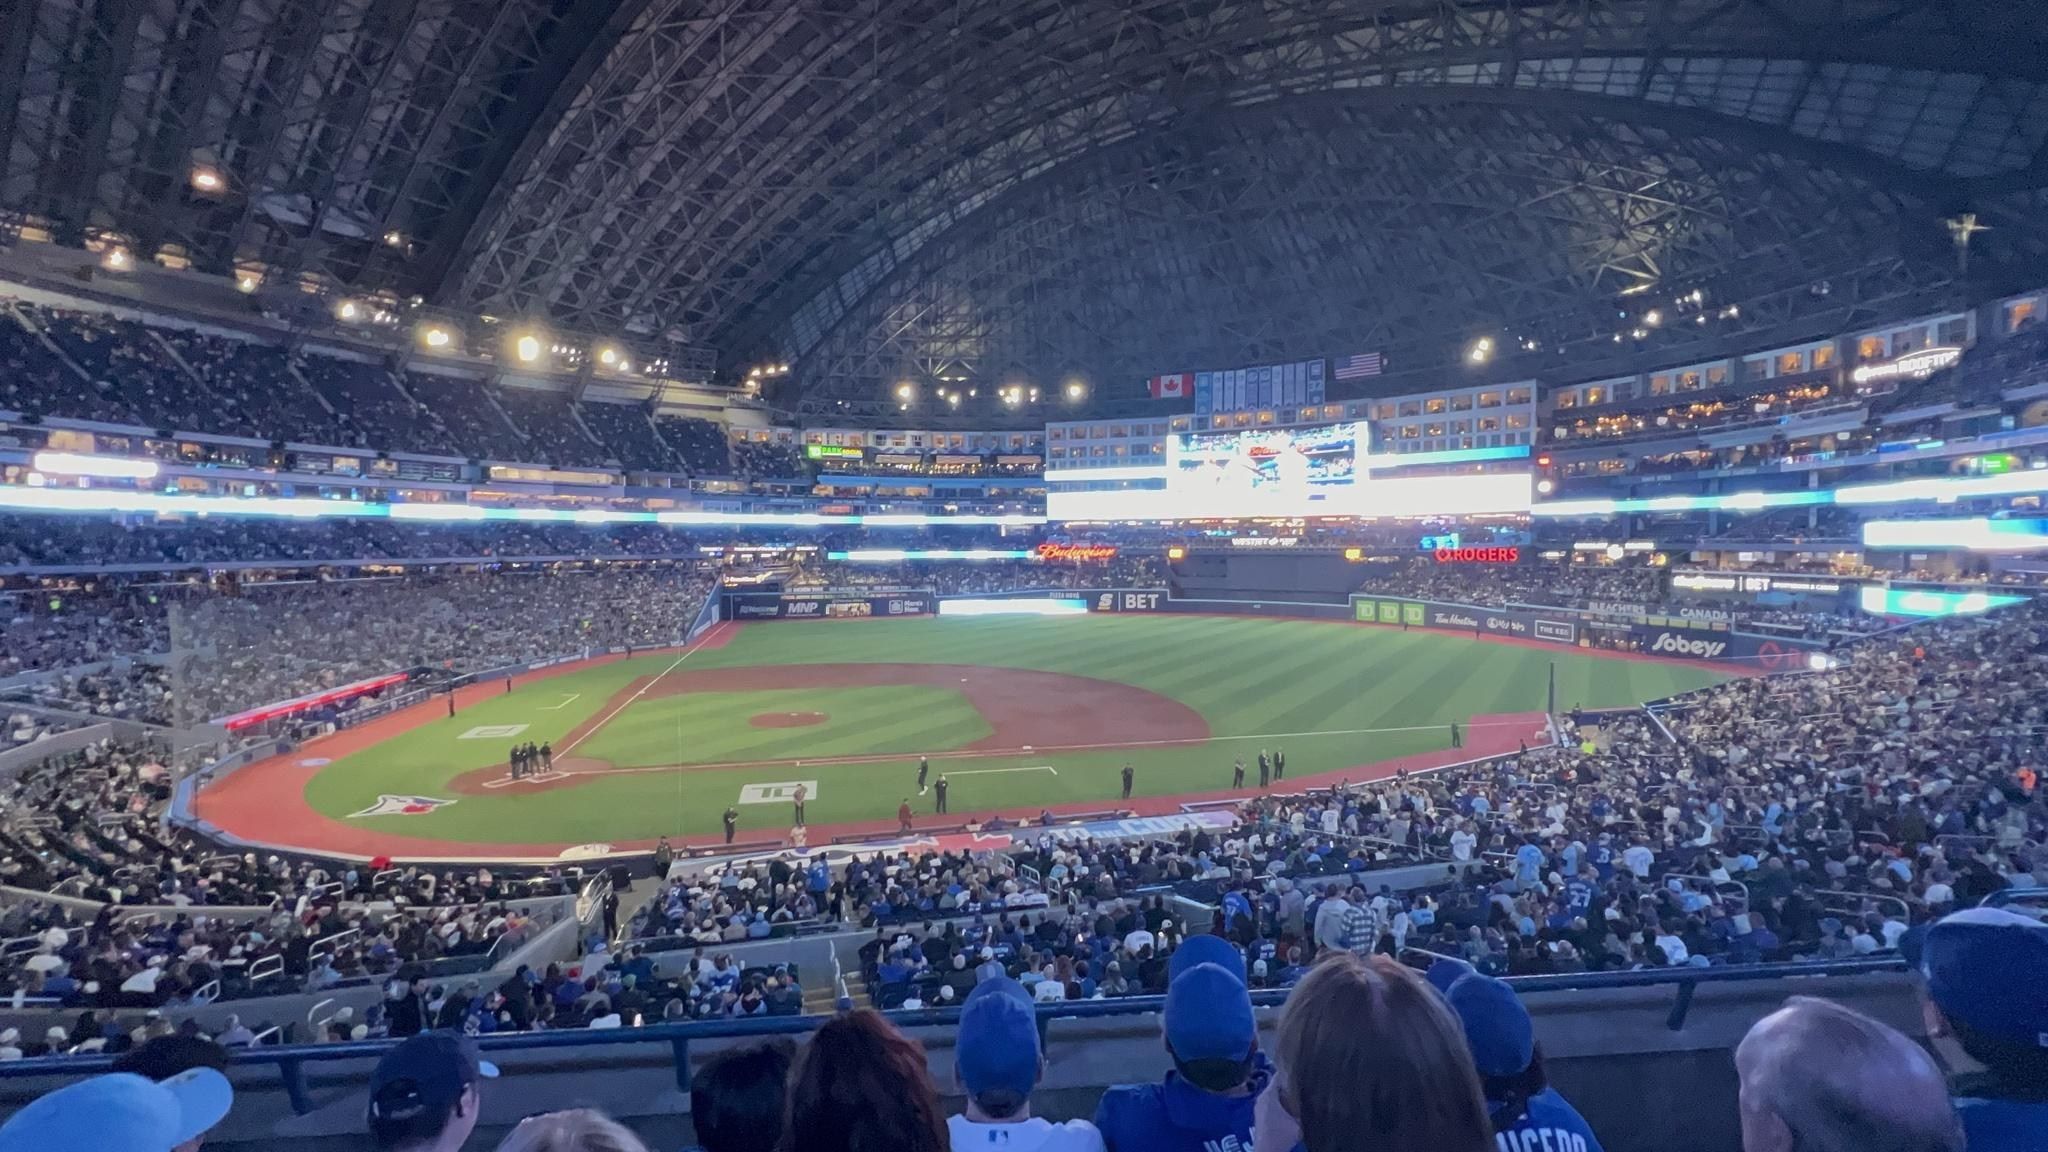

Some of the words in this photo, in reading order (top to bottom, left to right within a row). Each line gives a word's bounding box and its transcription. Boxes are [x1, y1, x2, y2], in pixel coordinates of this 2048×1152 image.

[1038, 544, 1117, 558] Budweiser
[1455, 548, 1518, 561] ROGERS
[787, 602, 818, 614] MNP
[1125, 594, 1159, 609] BET
[1680, 607, 1729, 621] CANADA
[1540, 625, 1553, 633] THE
[1652, 632, 1726, 657] Sobeys
